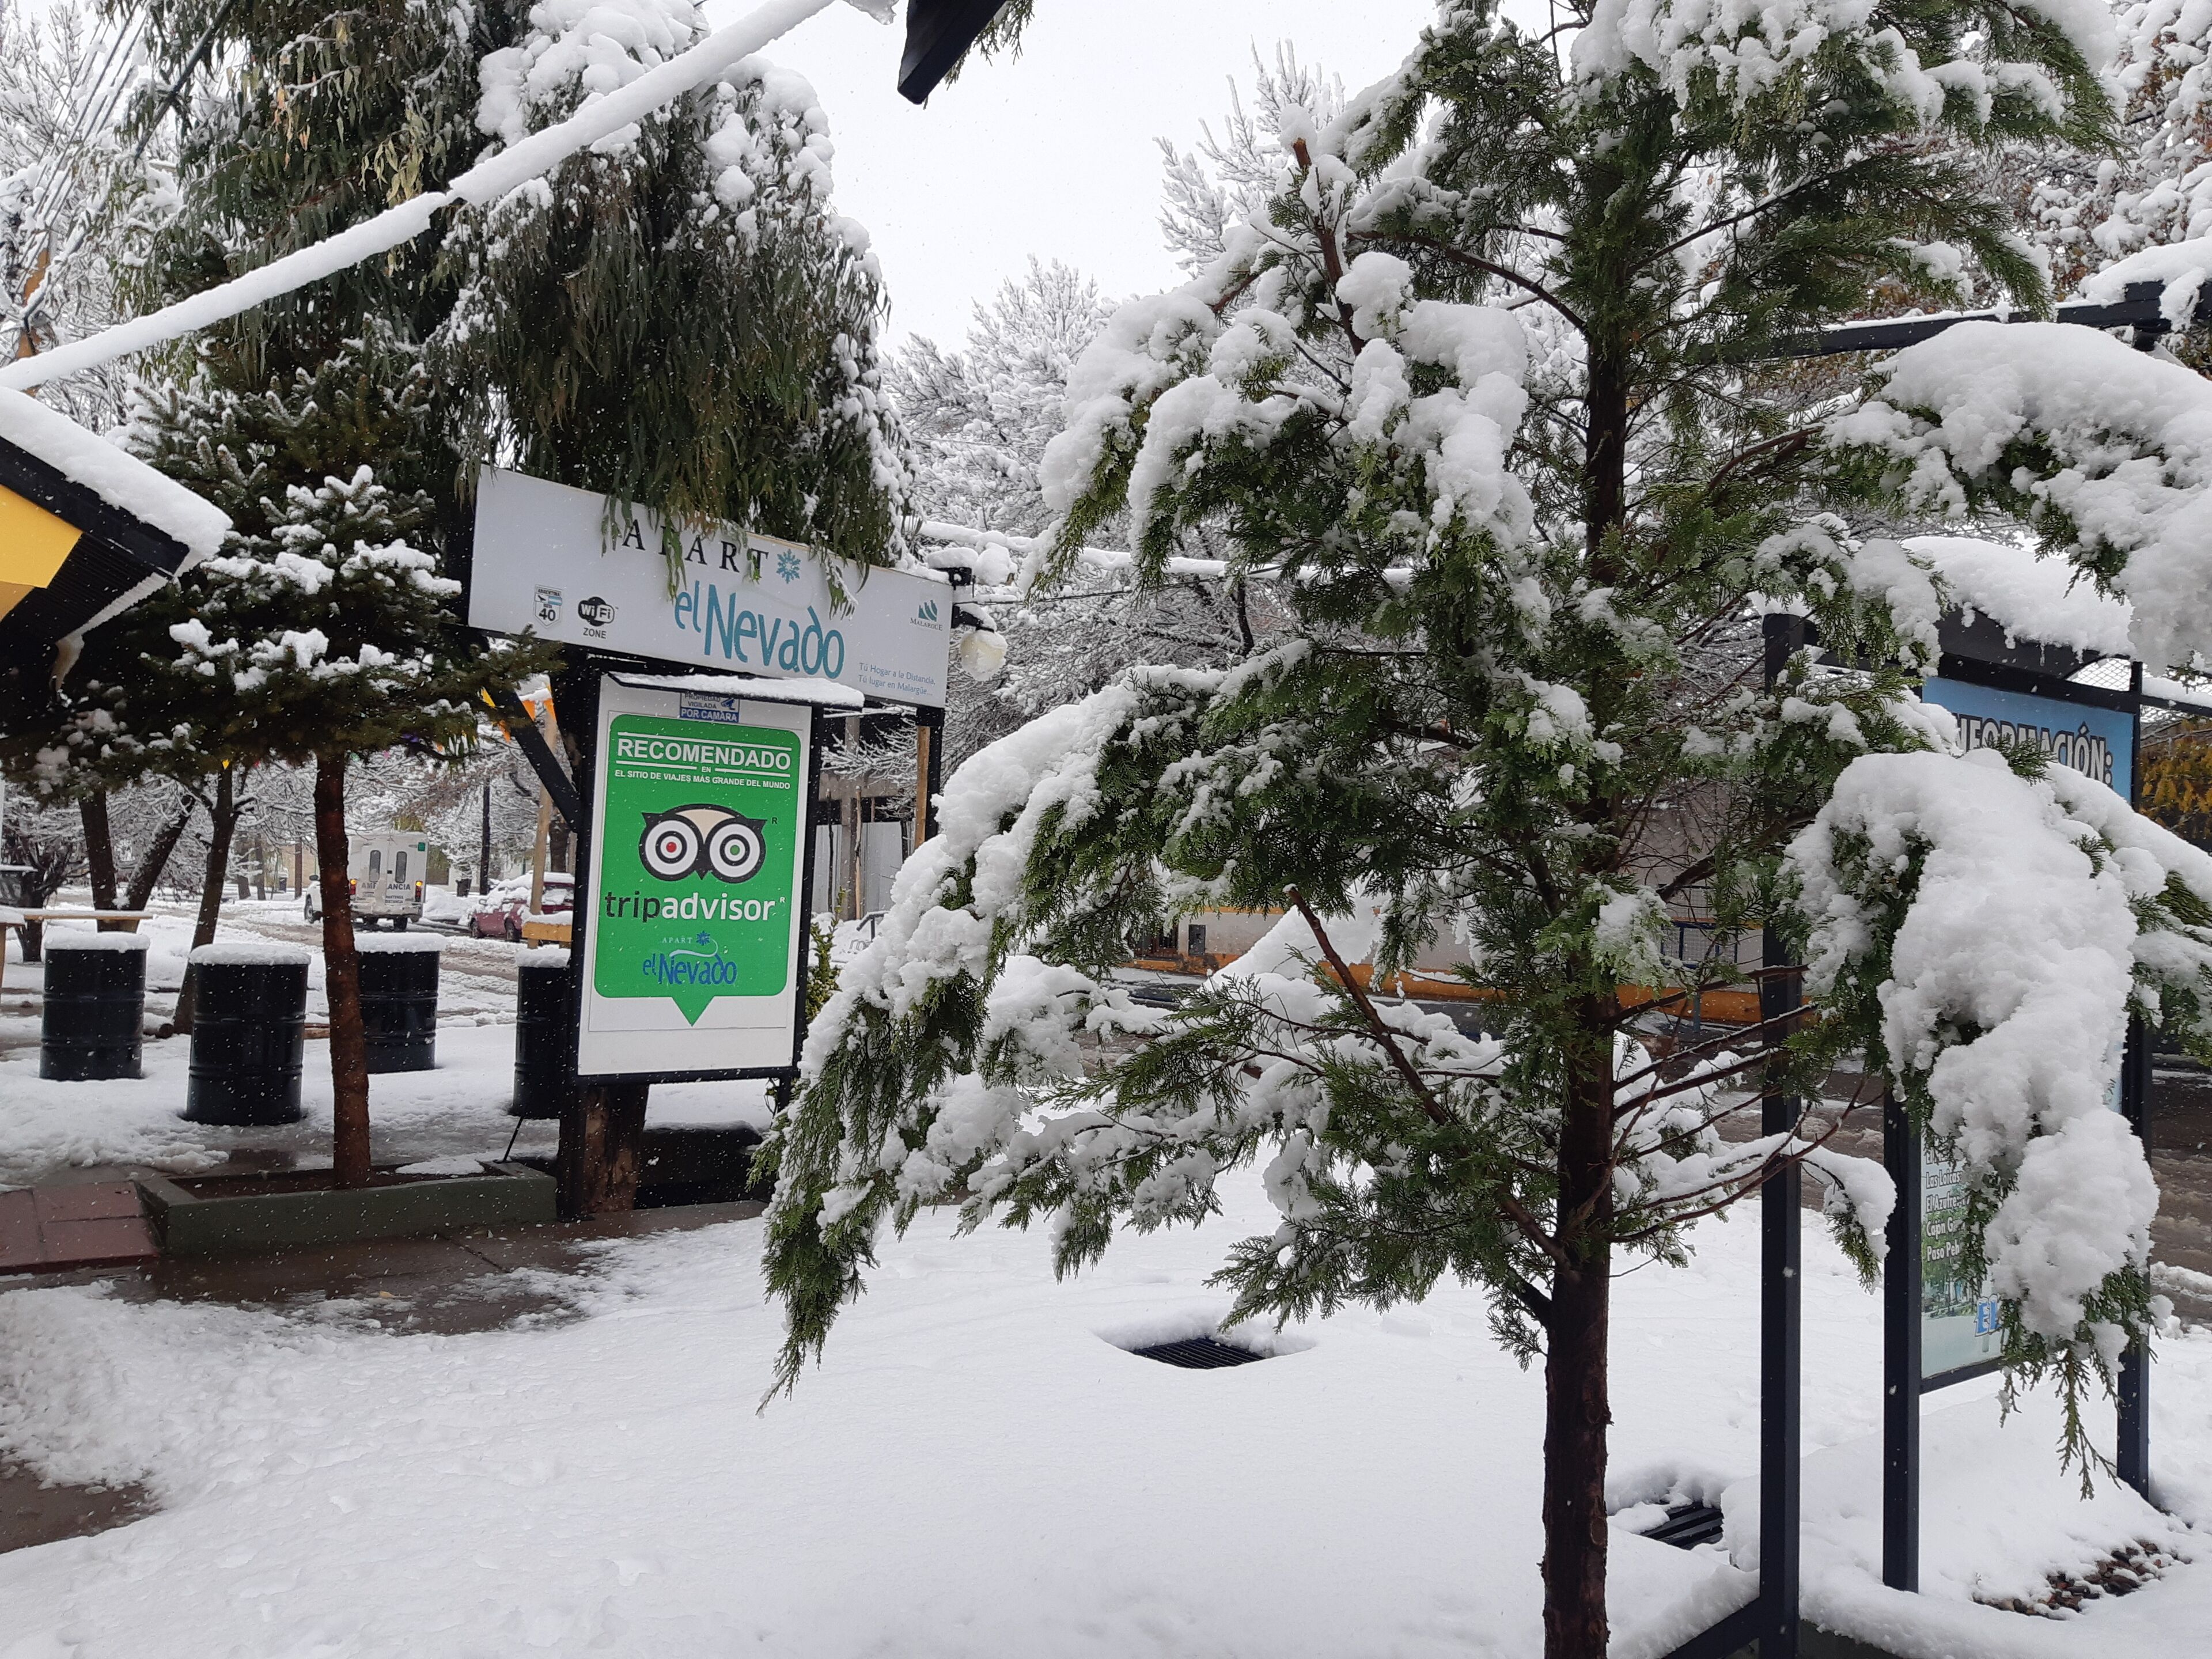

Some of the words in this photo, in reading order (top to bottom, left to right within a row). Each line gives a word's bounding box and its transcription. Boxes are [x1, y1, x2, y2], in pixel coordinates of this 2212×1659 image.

[539, 608, 556, 622] 40
[582, 627, 607, 639] ZONE
[859, 662, 868, 672] Tú
[870, 664, 891, 677] Hogar
[899, 670, 904, 679] la
[858, 675, 868, 683] Tú
[869, 676, 885, 687] lugar
[681, 709, 699, 718] POR
[688, 701, 717, 709] VIGILADA
[618, 738, 791, 770] RECOMENDADO
[627, 770, 649, 779] SITIO
[650, 772, 661, 780] DE
[663, 773, 691, 782] VIAJES
[712, 777, 745, 786] GRANDE
[746, 779, 762, 787] DEL
[763, 781, 791, 790] MUNDO
[361, 882, 411, 891] AMANCIA
[604, 891, 776, 923] tripadvisor
[1926, 1172, 1938, 1189] Las
[1939, 1169, 1960, 1187] Loicas
[1926, 1195, 1933, 1214] El
[1927, 1245, 1945, 1262] Paso
